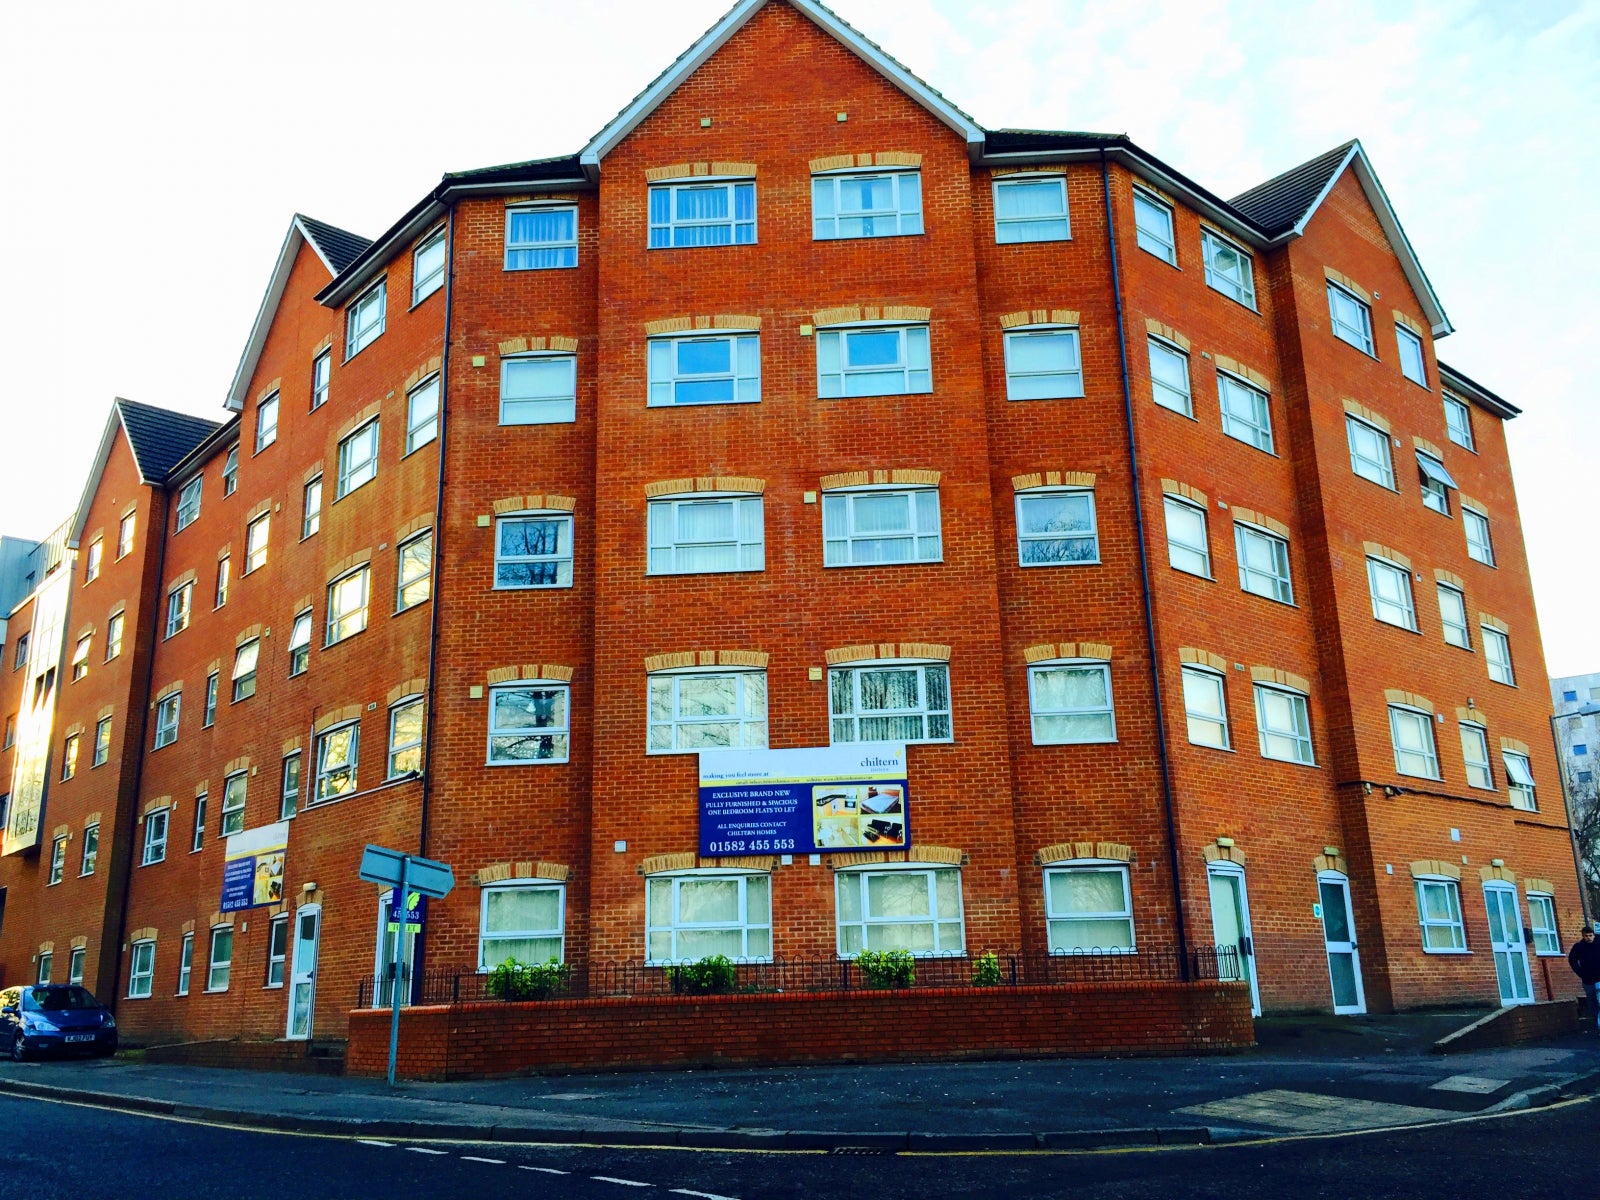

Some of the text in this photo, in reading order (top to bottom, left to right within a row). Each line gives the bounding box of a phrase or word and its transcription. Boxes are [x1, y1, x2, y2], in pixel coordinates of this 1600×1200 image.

[860, 757, 898, 767] chiltern
[712, 789, 791, 799] EXCLUSIVE BRAND NEW
[705, 801, 724, 809] FULLY
[725, 800, 761, 808] FURNISHED
[768, 798, 798, 806] SPACIOUS
[709, 838, 795, 852] 01582 455 553
